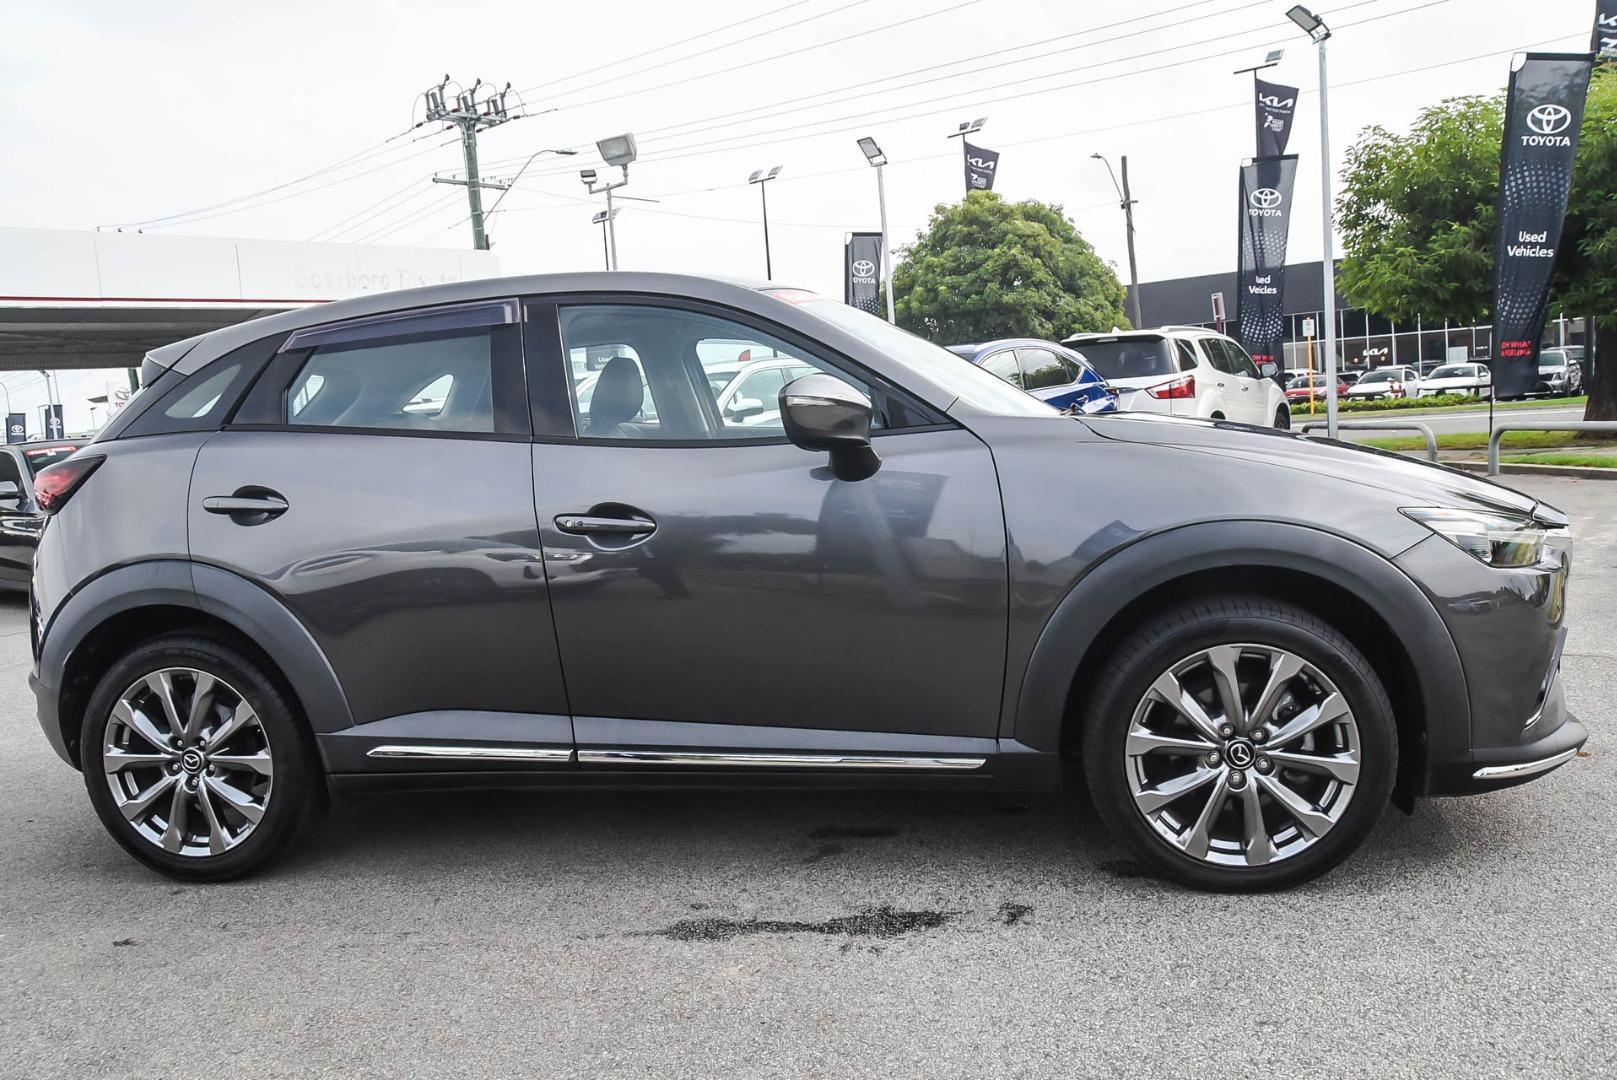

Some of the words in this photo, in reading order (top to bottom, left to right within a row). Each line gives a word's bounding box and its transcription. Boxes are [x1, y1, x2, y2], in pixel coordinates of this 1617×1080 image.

[1521, 136, 1571, 147] TOYOTA
[1519, 231, 1547, 243] Used
[1507, 245, 1554, 258] Vehicles
